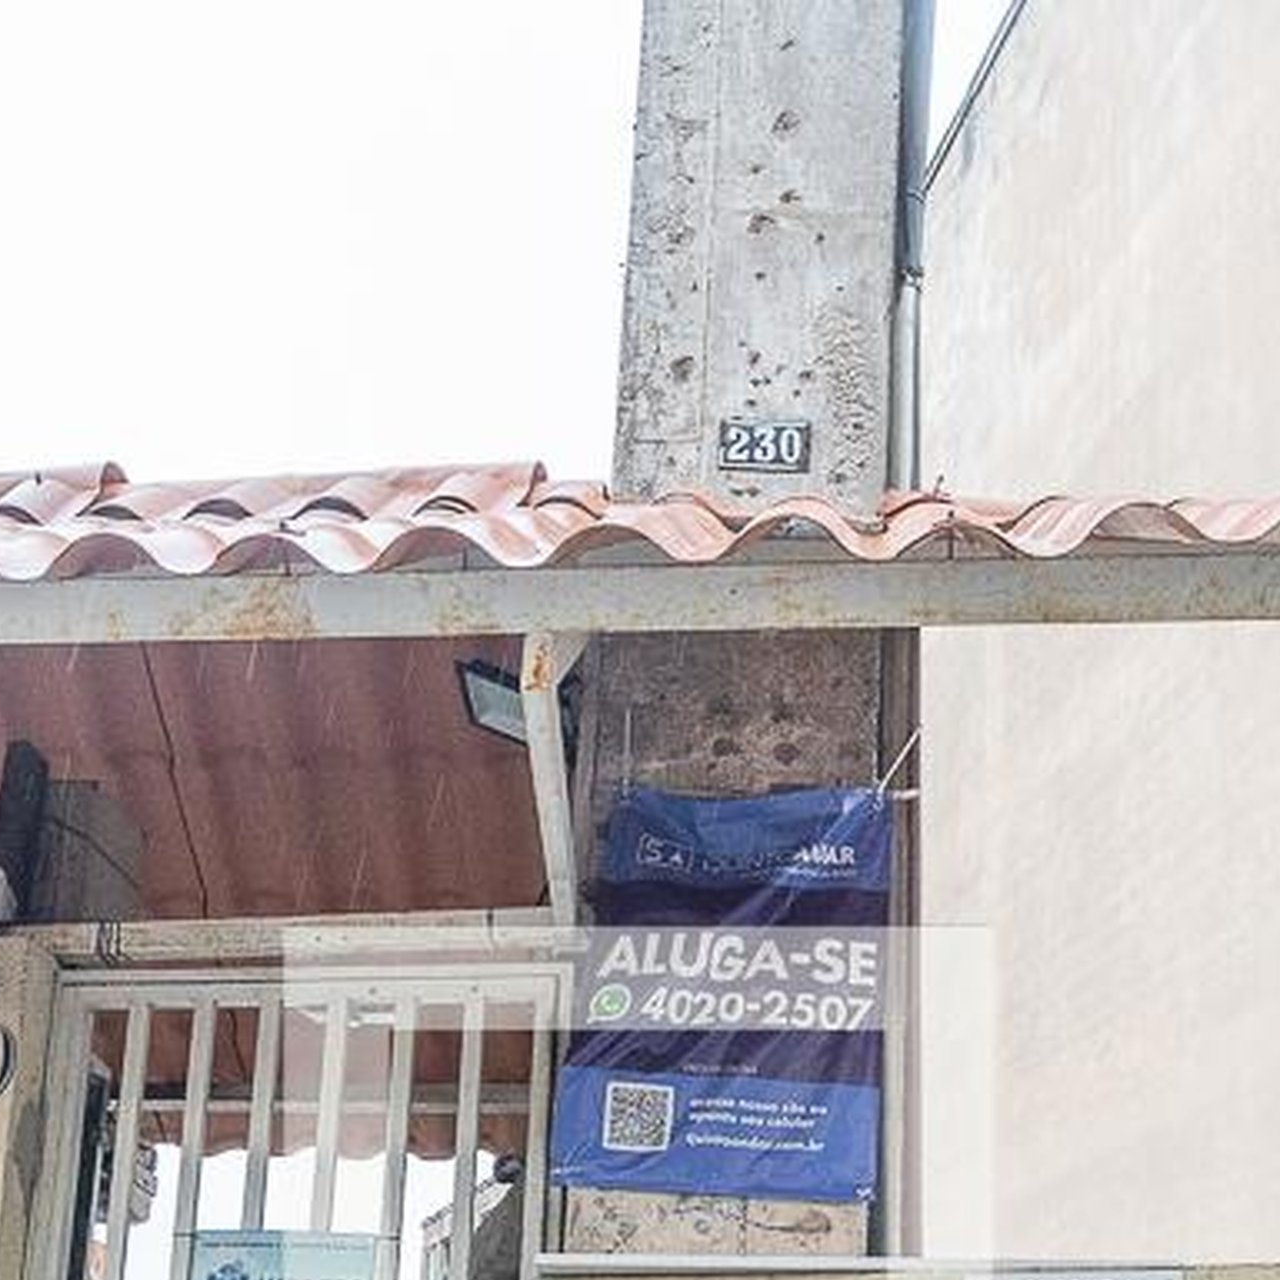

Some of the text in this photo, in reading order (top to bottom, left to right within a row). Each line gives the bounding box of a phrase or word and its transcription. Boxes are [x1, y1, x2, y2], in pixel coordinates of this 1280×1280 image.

[726, 425, 801, 463] 230
[597, 932, 878, 987] ALUGA-SE
[640, 986, 875, 1031] 4020-2507
